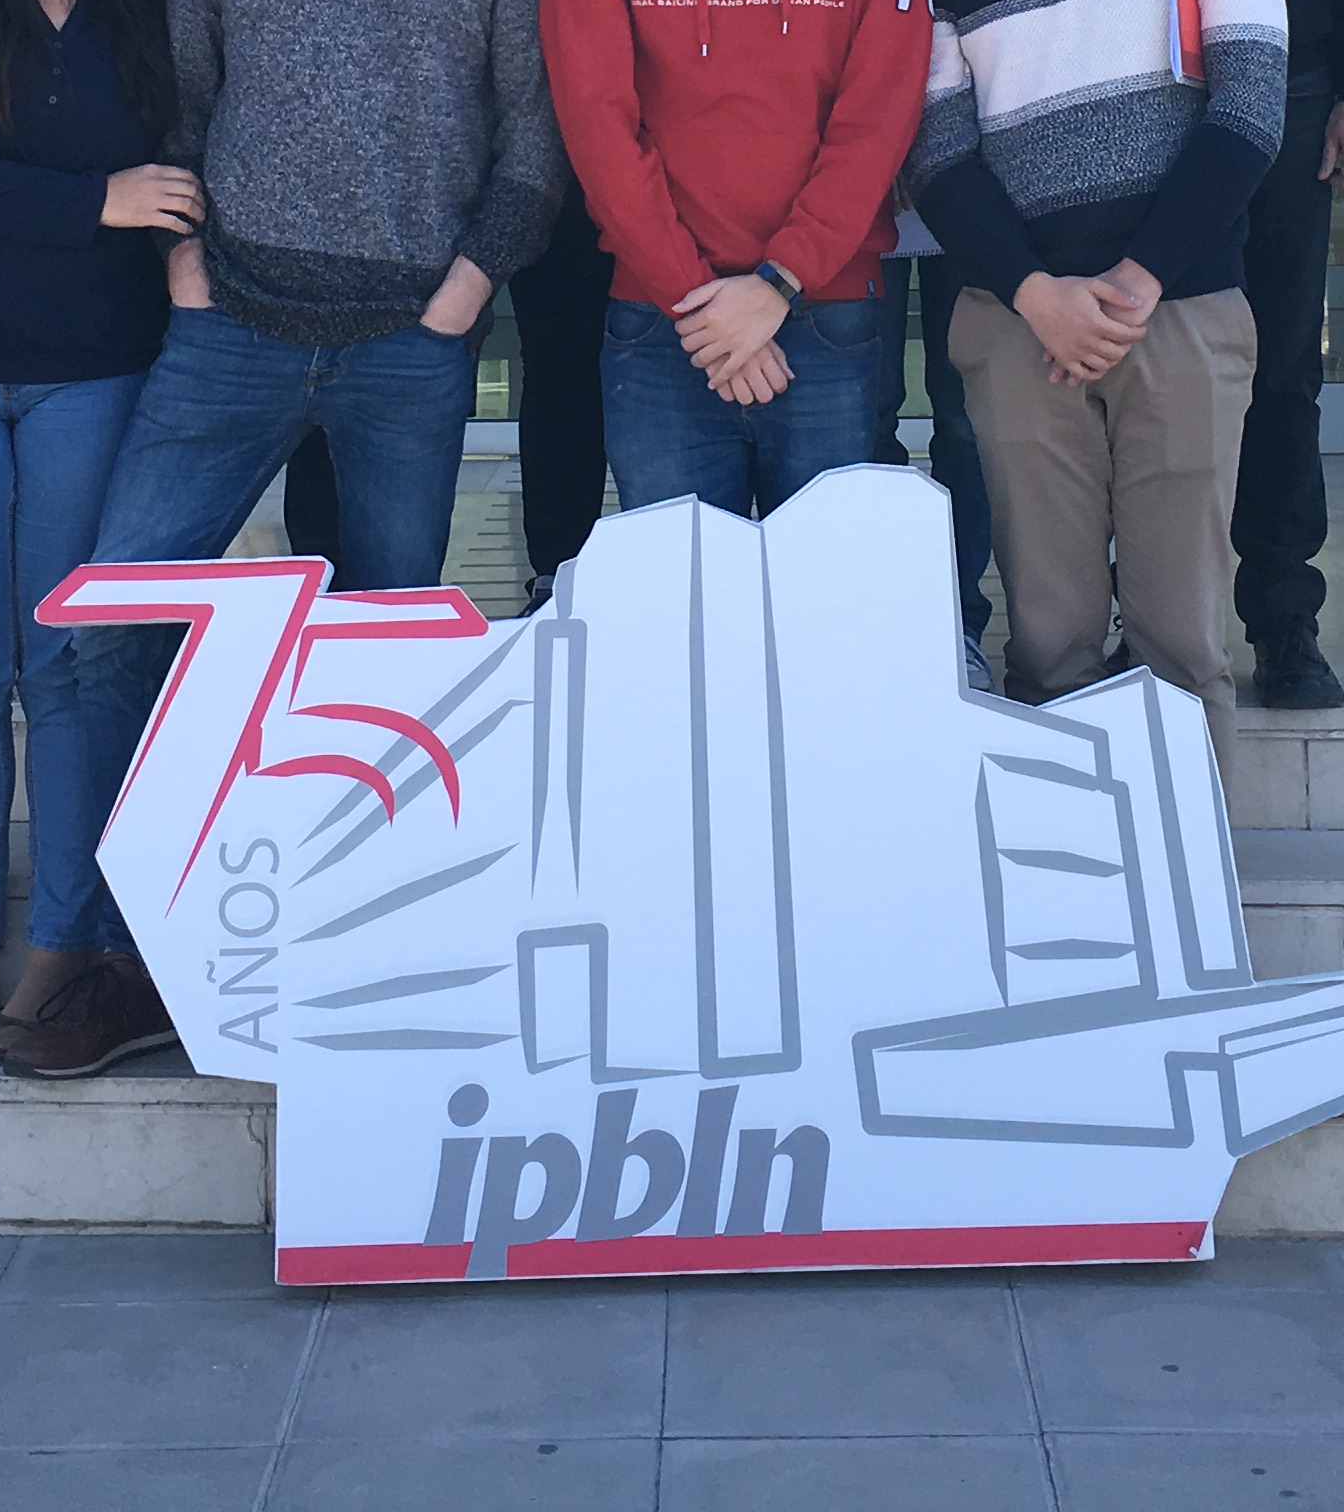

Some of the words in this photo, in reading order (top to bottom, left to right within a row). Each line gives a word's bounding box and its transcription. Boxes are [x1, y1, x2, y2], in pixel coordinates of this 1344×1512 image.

[657, 0, 698, 7] SAILIN
[707, 0, 744, 7] BRAND
[34, 559, 490, 921] 75
[206, 837, 281, 1055] AÑOS
[422, 1082, 832, 1281] ipbln
